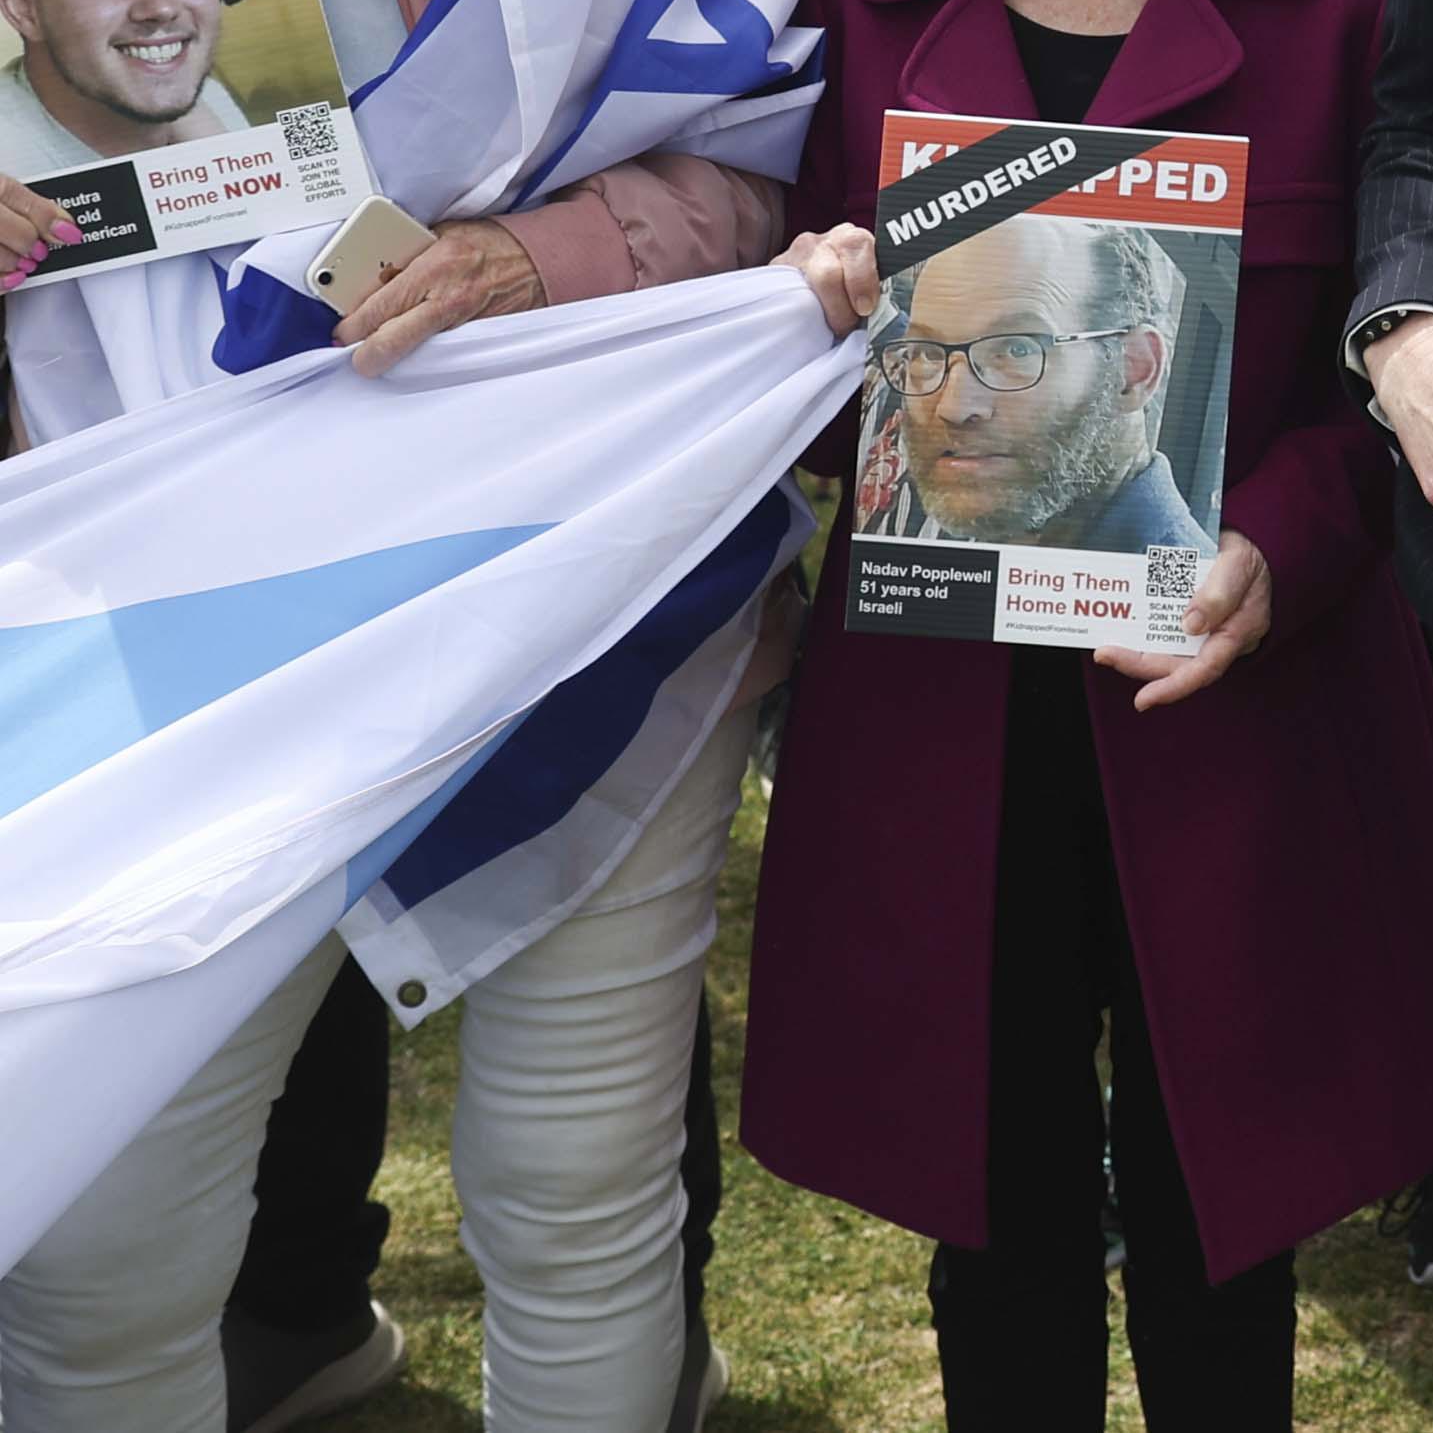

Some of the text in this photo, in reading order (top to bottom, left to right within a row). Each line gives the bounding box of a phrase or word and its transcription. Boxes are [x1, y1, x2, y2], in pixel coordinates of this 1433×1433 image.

[148, 152, 274, 189] Bring Them
[325, 158, 337, 167] TO
[299, 170, 322, 183] JOIN
[901, 141, 1228, 204] KPPED
[304, 178, 343, 193] GLOBAL
[885, 136, 1077, 246] MURDERED
[155, 173, 290, 215] Home NOW.
[305, 188, 347, 203] EFFORTS
[77, 208, 102, 225] old
[861, 561, 992, 584] Nadav Popplewell
[1008, 568, 1129, 593] Bring Them
[860, 580, 948, 599] 51 years old
[859, 599, 903, 615] Israeli
[1006, 594, 1136, 620] Home NOW.
[1149, 602, 1174, 612] SCAN
[1148, 612, 1183, 622] JOIN TH
[1148, 623, 1183, 633] GLOBA
[1146, 633, 1187, 643] EFFORTS
